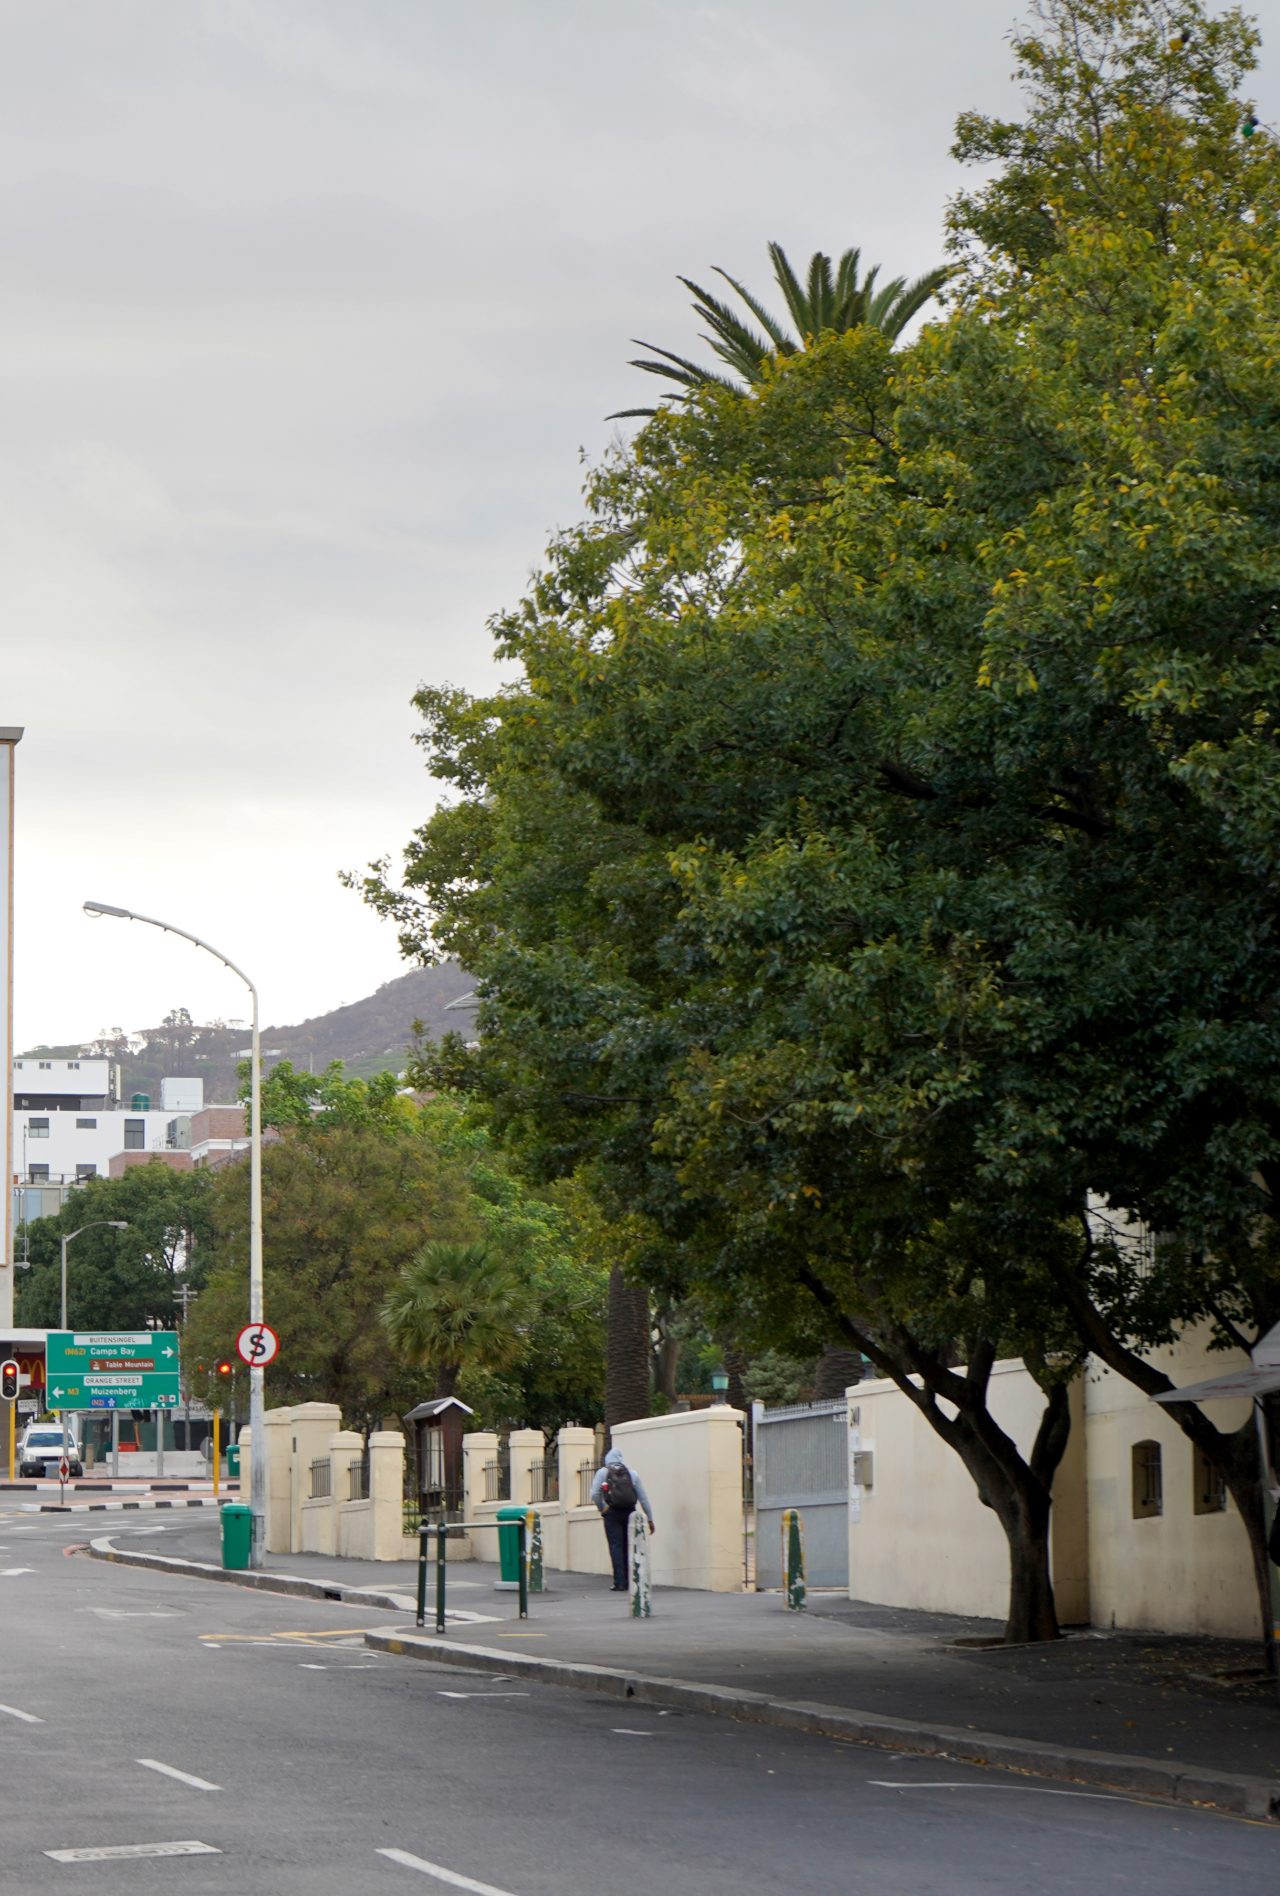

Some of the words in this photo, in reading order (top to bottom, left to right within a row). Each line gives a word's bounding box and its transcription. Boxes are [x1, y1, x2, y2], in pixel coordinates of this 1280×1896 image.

[249, 1333, 266, 1357] S
[90, 1347, 118, 1356] Camps
[120, 1347, 136, 1357] Bay
[90, 1388, 137, 1397] Muizenberg
